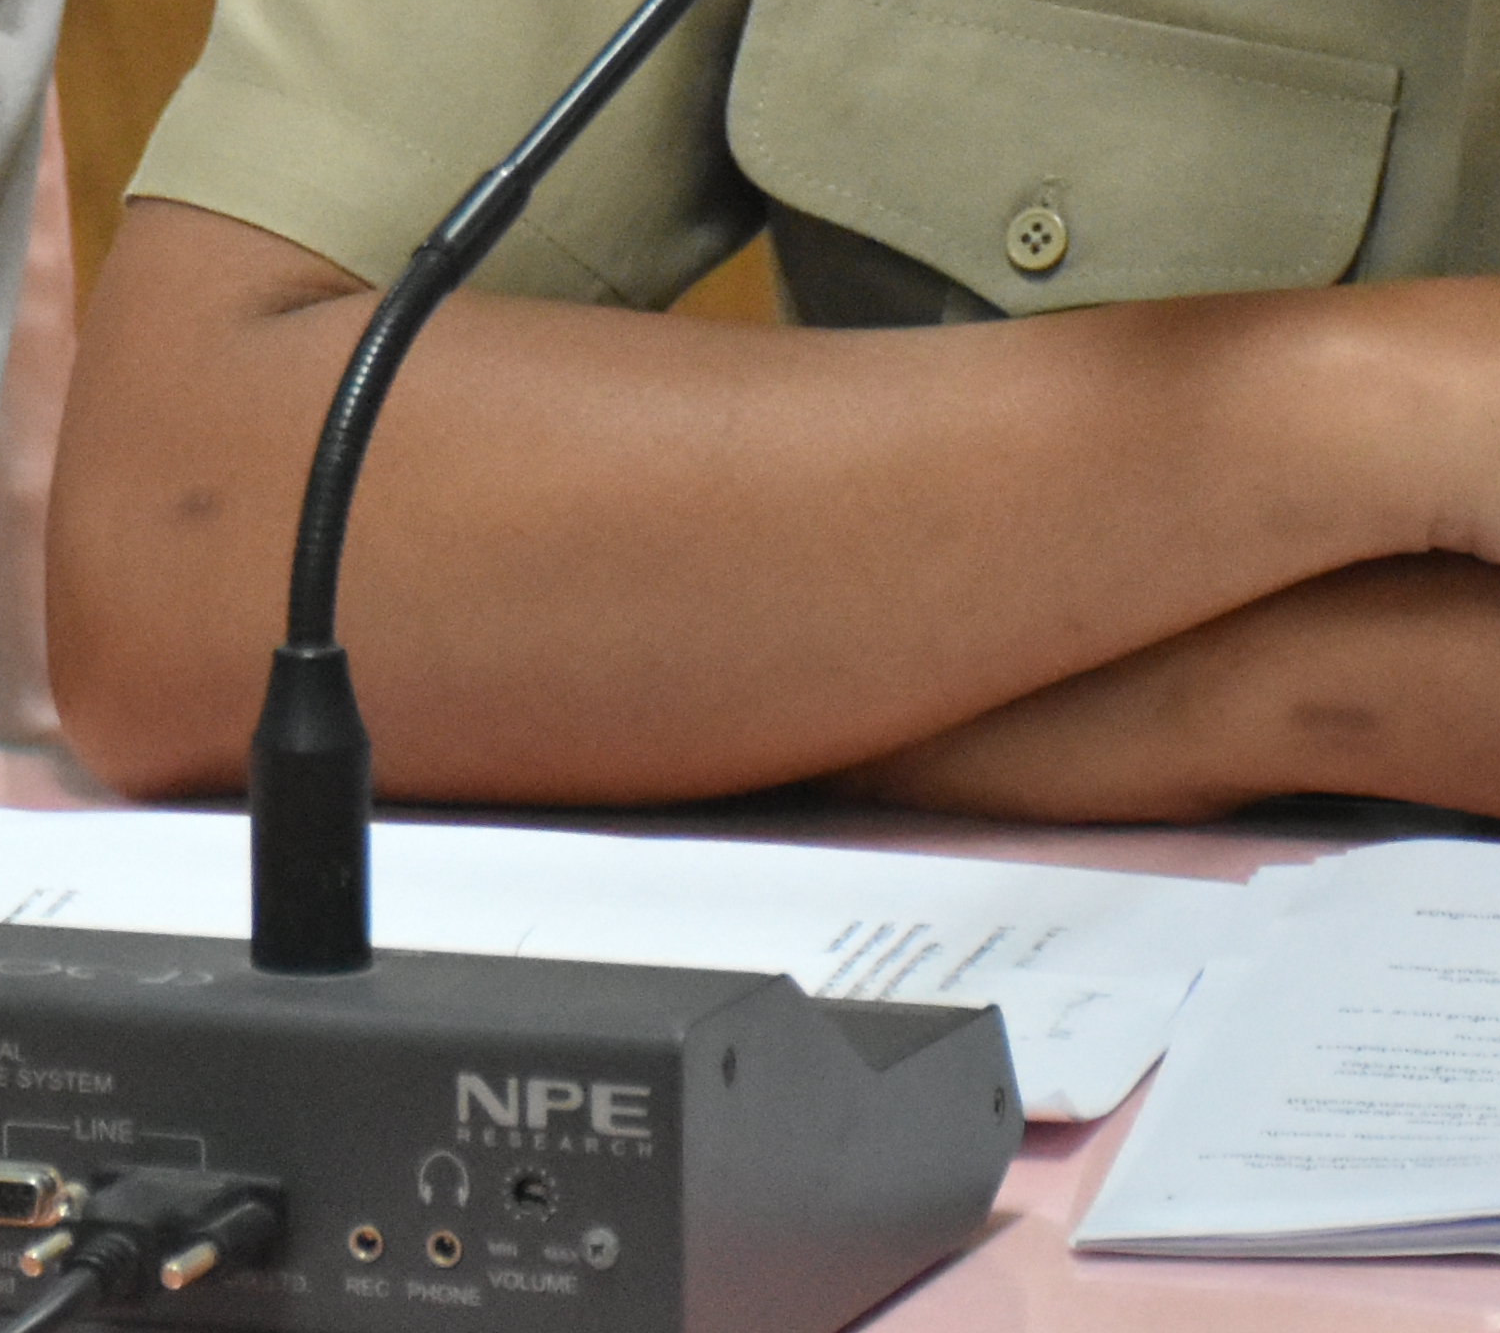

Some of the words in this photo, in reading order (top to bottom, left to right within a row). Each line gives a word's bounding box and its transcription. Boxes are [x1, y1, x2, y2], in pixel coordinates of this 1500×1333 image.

[15, 1069, 114, 1094] SYSTEM
[456, 1071, 652, 1139] NPE
[74, 1116, 134, 1145] LINE
[456, 1127, 654, 1158] RESEARCH
[345, 1275, 390, 1299] REC
[406, 1280, 482, 1308] PHONE
[487, 1272, 579, 1296] VOLUME
